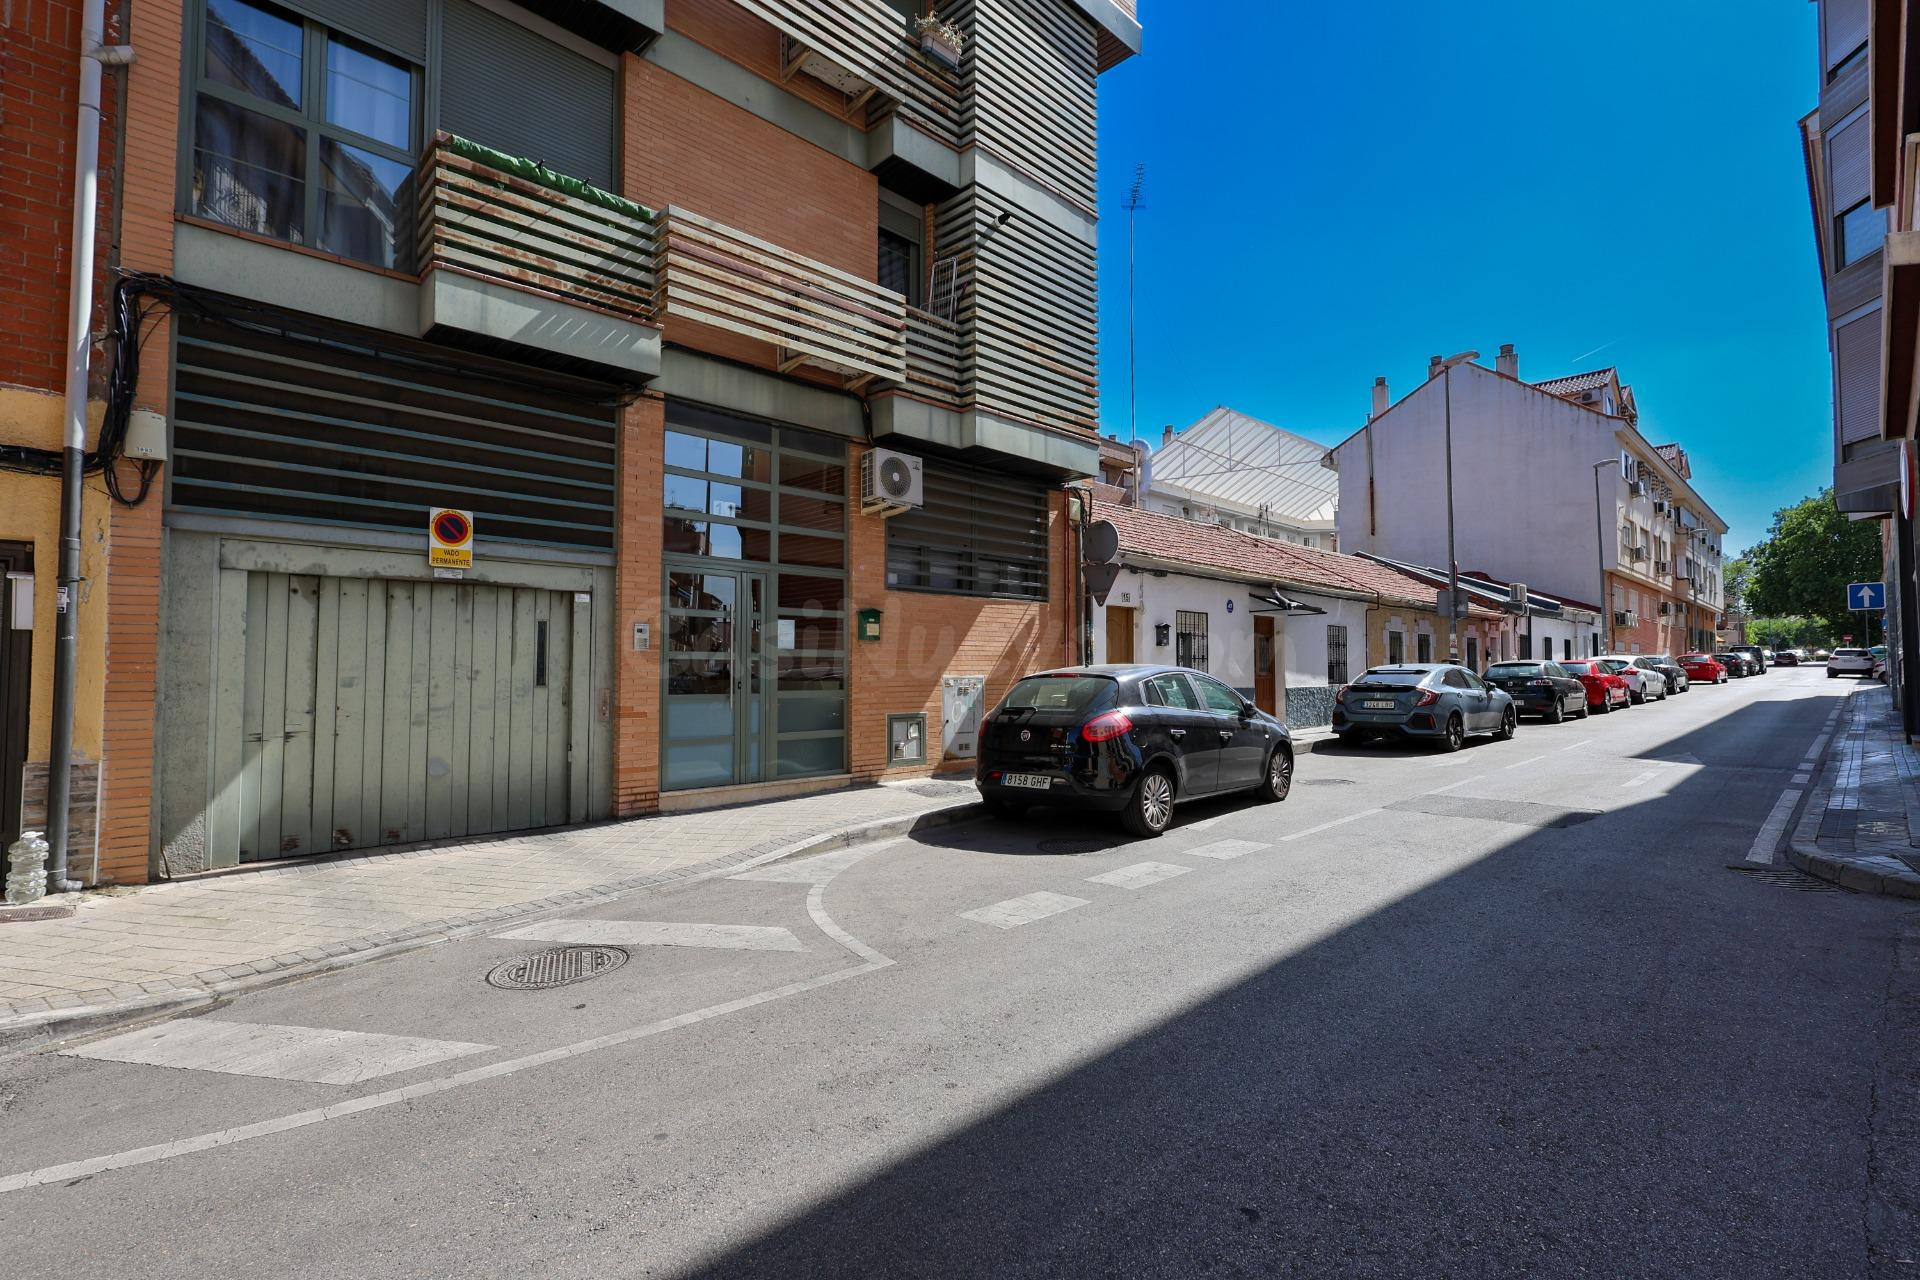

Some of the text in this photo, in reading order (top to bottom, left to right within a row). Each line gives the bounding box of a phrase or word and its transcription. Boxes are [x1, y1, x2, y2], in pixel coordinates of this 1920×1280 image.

[443, 549, 460, 557] VADO
[432, 557, 470, 566] PERMANENTE
[1007, 774, 1049, 788] 8158 GHF
